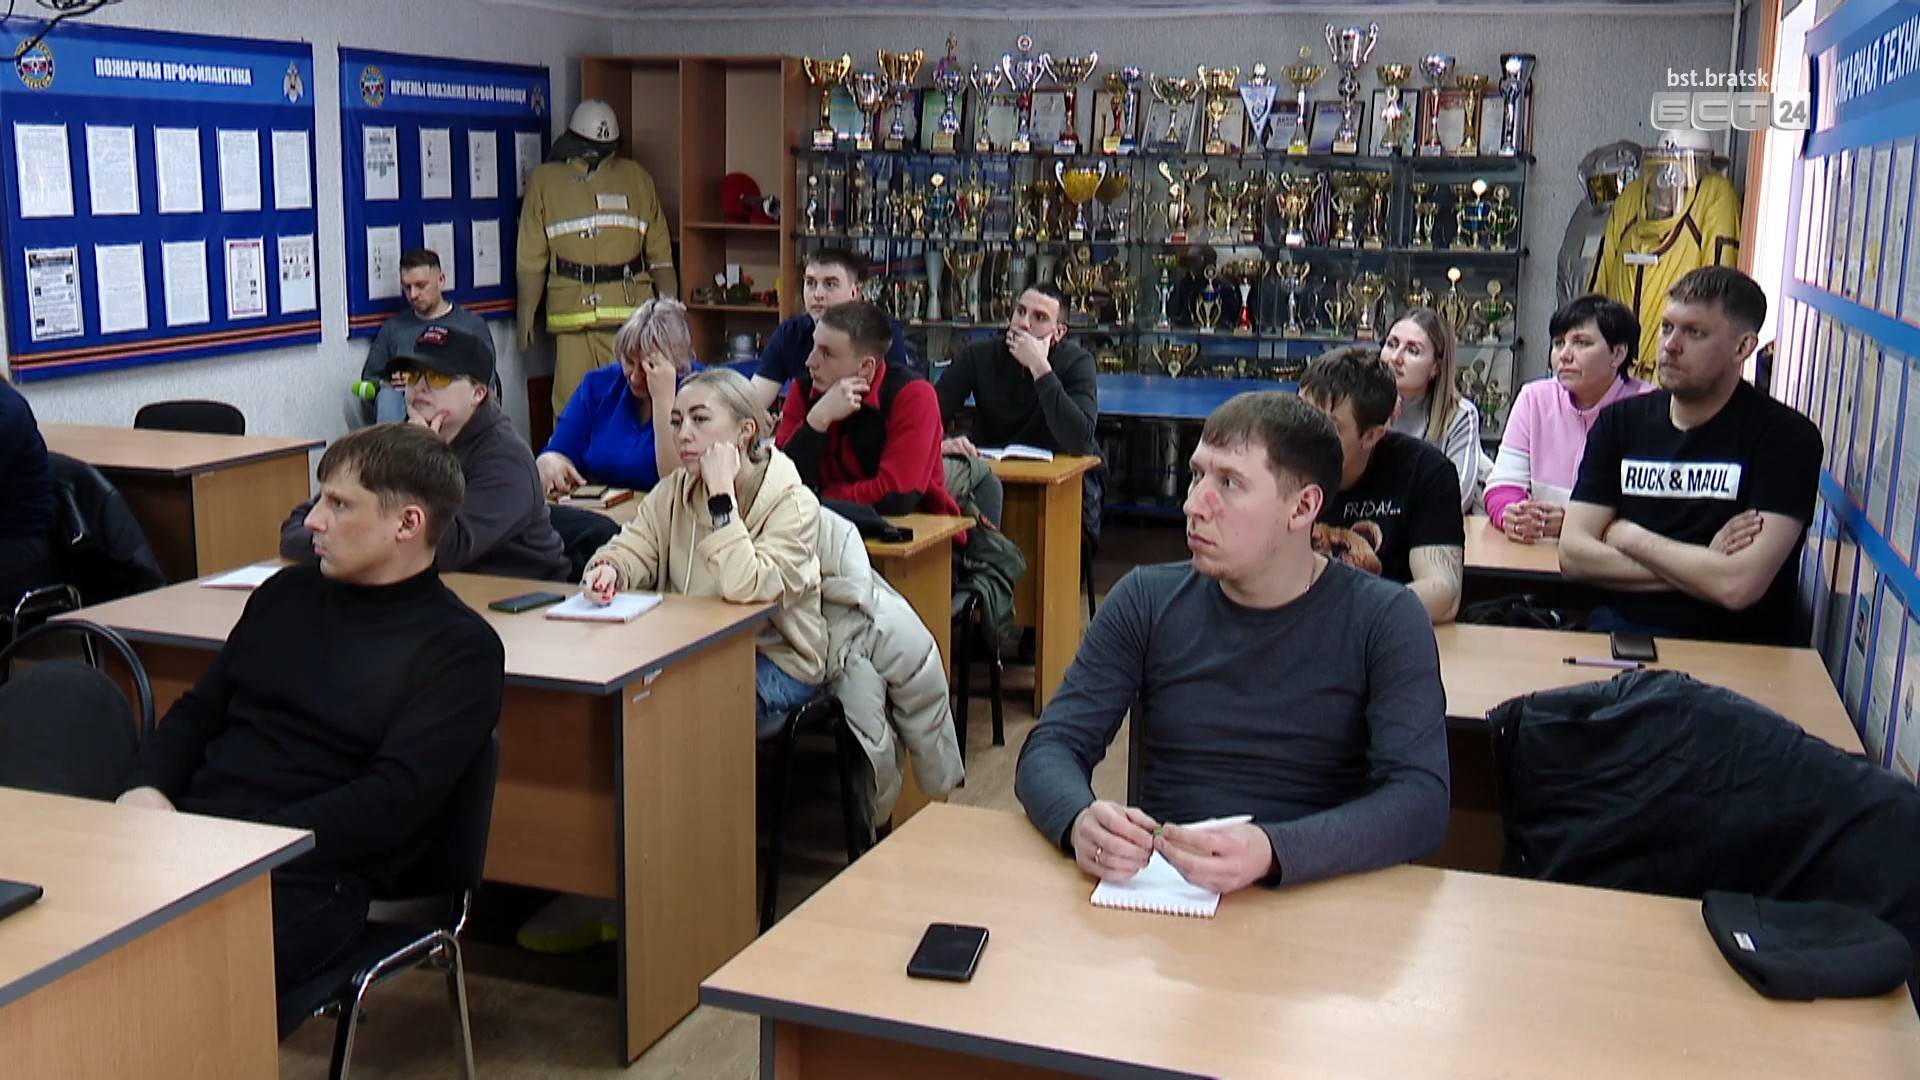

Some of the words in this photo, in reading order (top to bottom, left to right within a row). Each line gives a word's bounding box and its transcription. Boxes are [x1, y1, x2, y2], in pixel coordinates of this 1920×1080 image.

[95, 57, 162, 80] ПОЖАРНАЯ
[163, 62, 253, 86] ПРОФИЛАКТИКА
[1829, 38, 1880, 107] ОЖАРНАЯ
[1881, 12, 1920, 86] ТЕХНИ
[391, 79, 426, 97] ПРИЕМЫ
[427, 82, 466, 99] ОКАЗАНИЯ
[467, 84, 495, 101] ПЕРВОЙ
[496, 87, 527, 104] ПОМОЩИ
[1625, 466, 1665, 491] RUCK
[1668, 468, 1683, 491] &
[1687, 468, 1730, 493] MAUL
